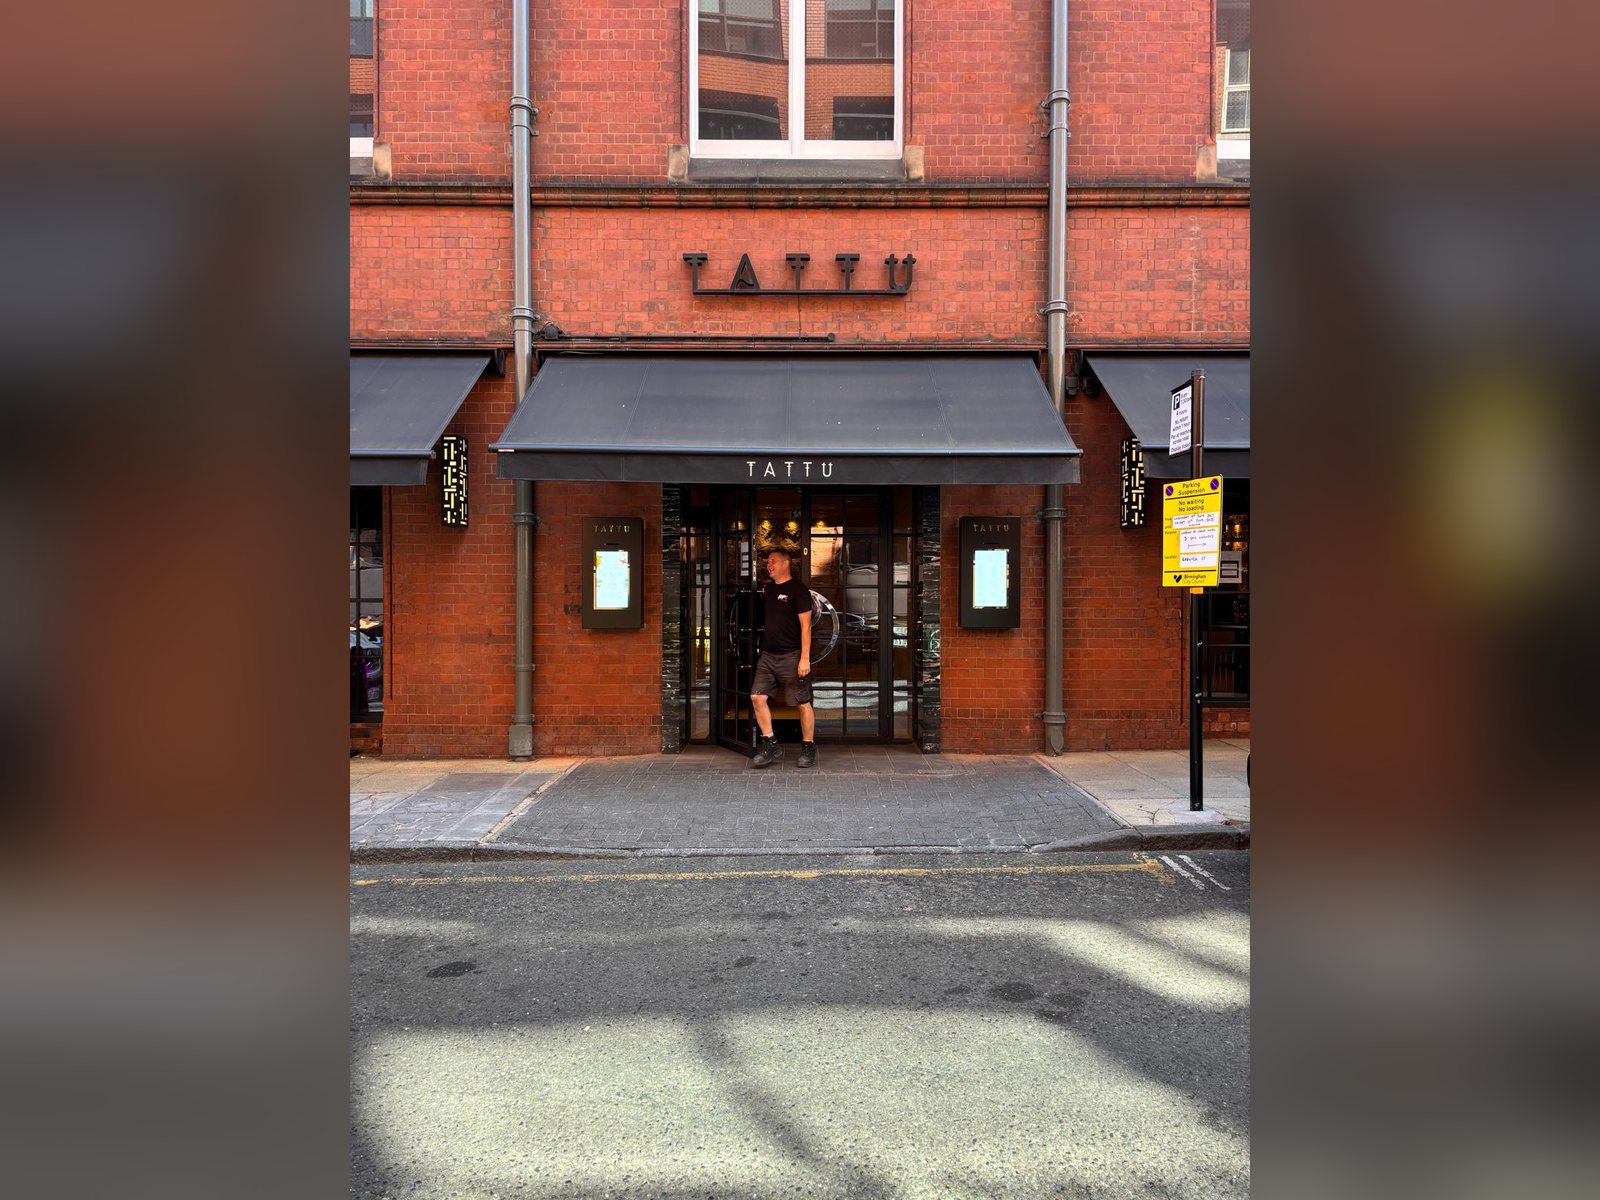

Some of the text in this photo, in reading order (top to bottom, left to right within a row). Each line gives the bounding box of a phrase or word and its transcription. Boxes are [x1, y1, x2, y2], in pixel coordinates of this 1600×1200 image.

[683, 253, 916, 293] TATTU
[746, 461, 833, 477] TATTU
[1178, 488, 1205, 496] Suspension
[593, 525, 630, 533] TATTU
[973, 524, 1009, 532] TATTU
